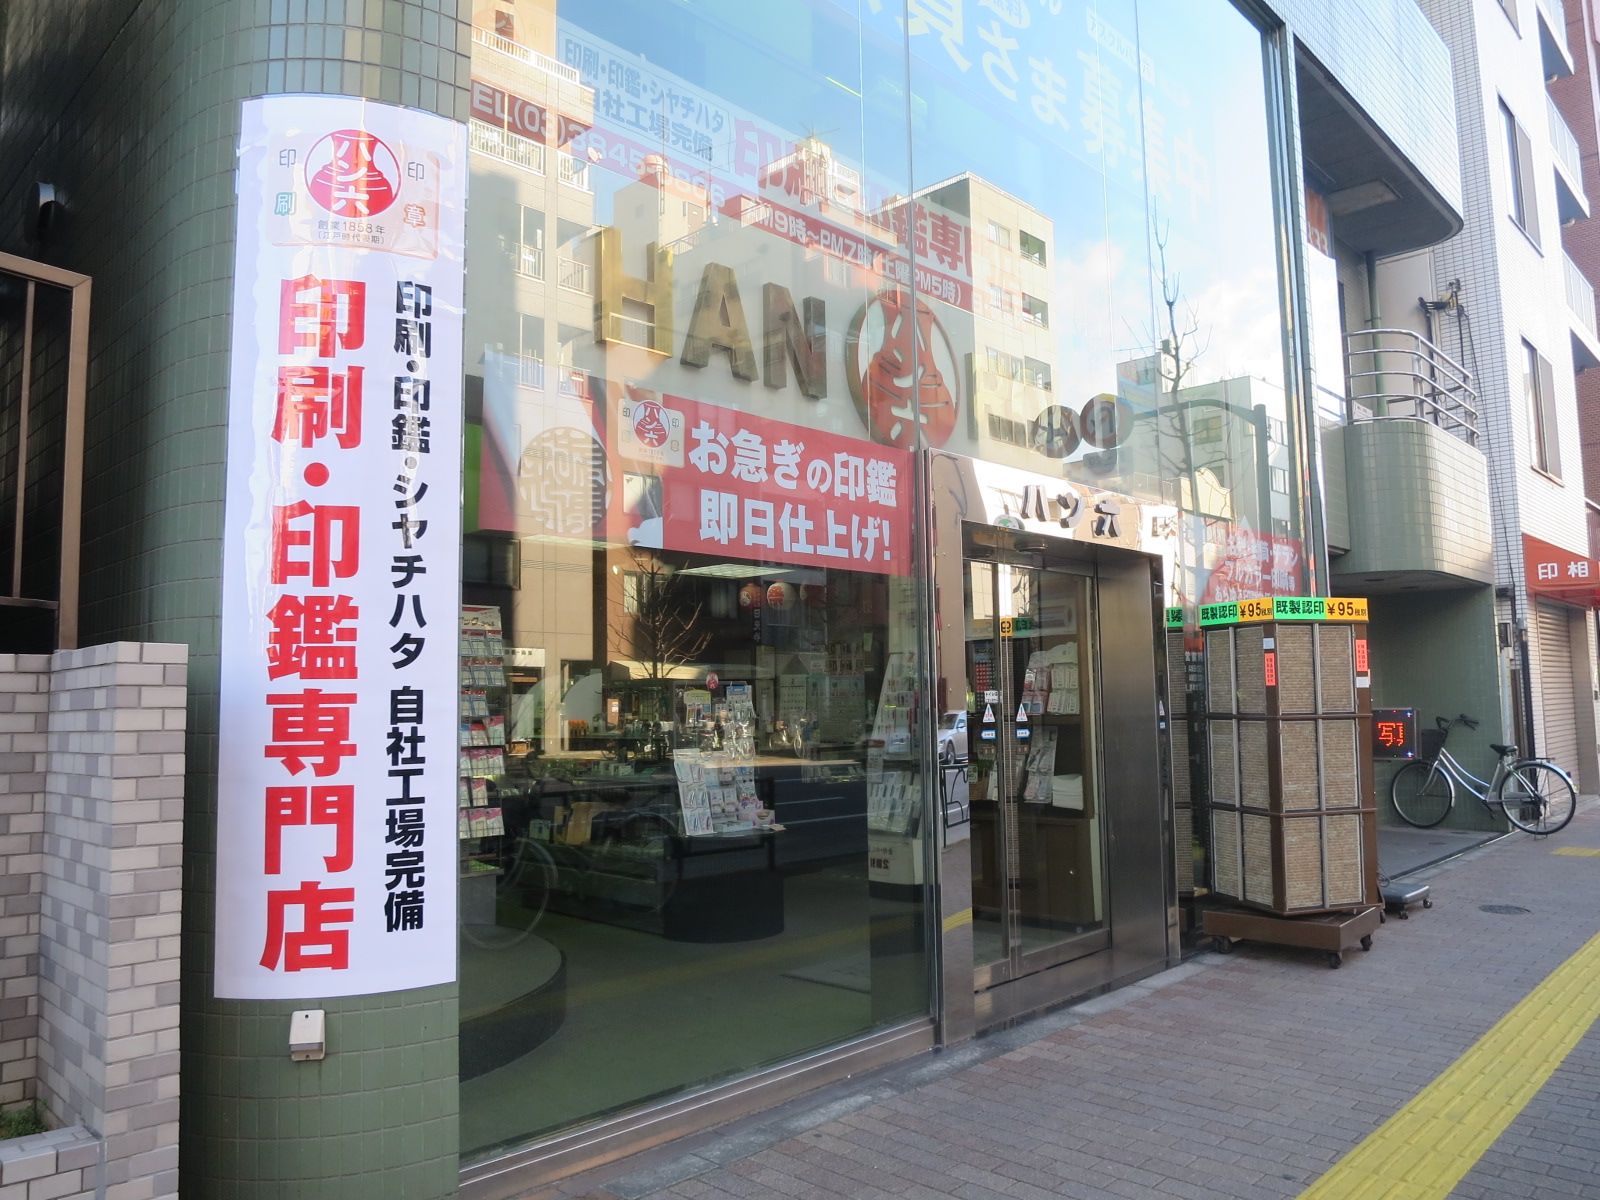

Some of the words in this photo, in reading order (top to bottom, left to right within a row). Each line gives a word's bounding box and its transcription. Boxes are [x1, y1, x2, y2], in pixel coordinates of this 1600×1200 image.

[687, 419, 897, 506] お急ぎの印鑑
[259, 273, 367, 973] 印刷・印鑑専門店
[1201, 604, 1237, 621] 既製認印
[1276, 600, 1324, 615] 既製認印
[384, 686, 426, 933] 自社工場完備
